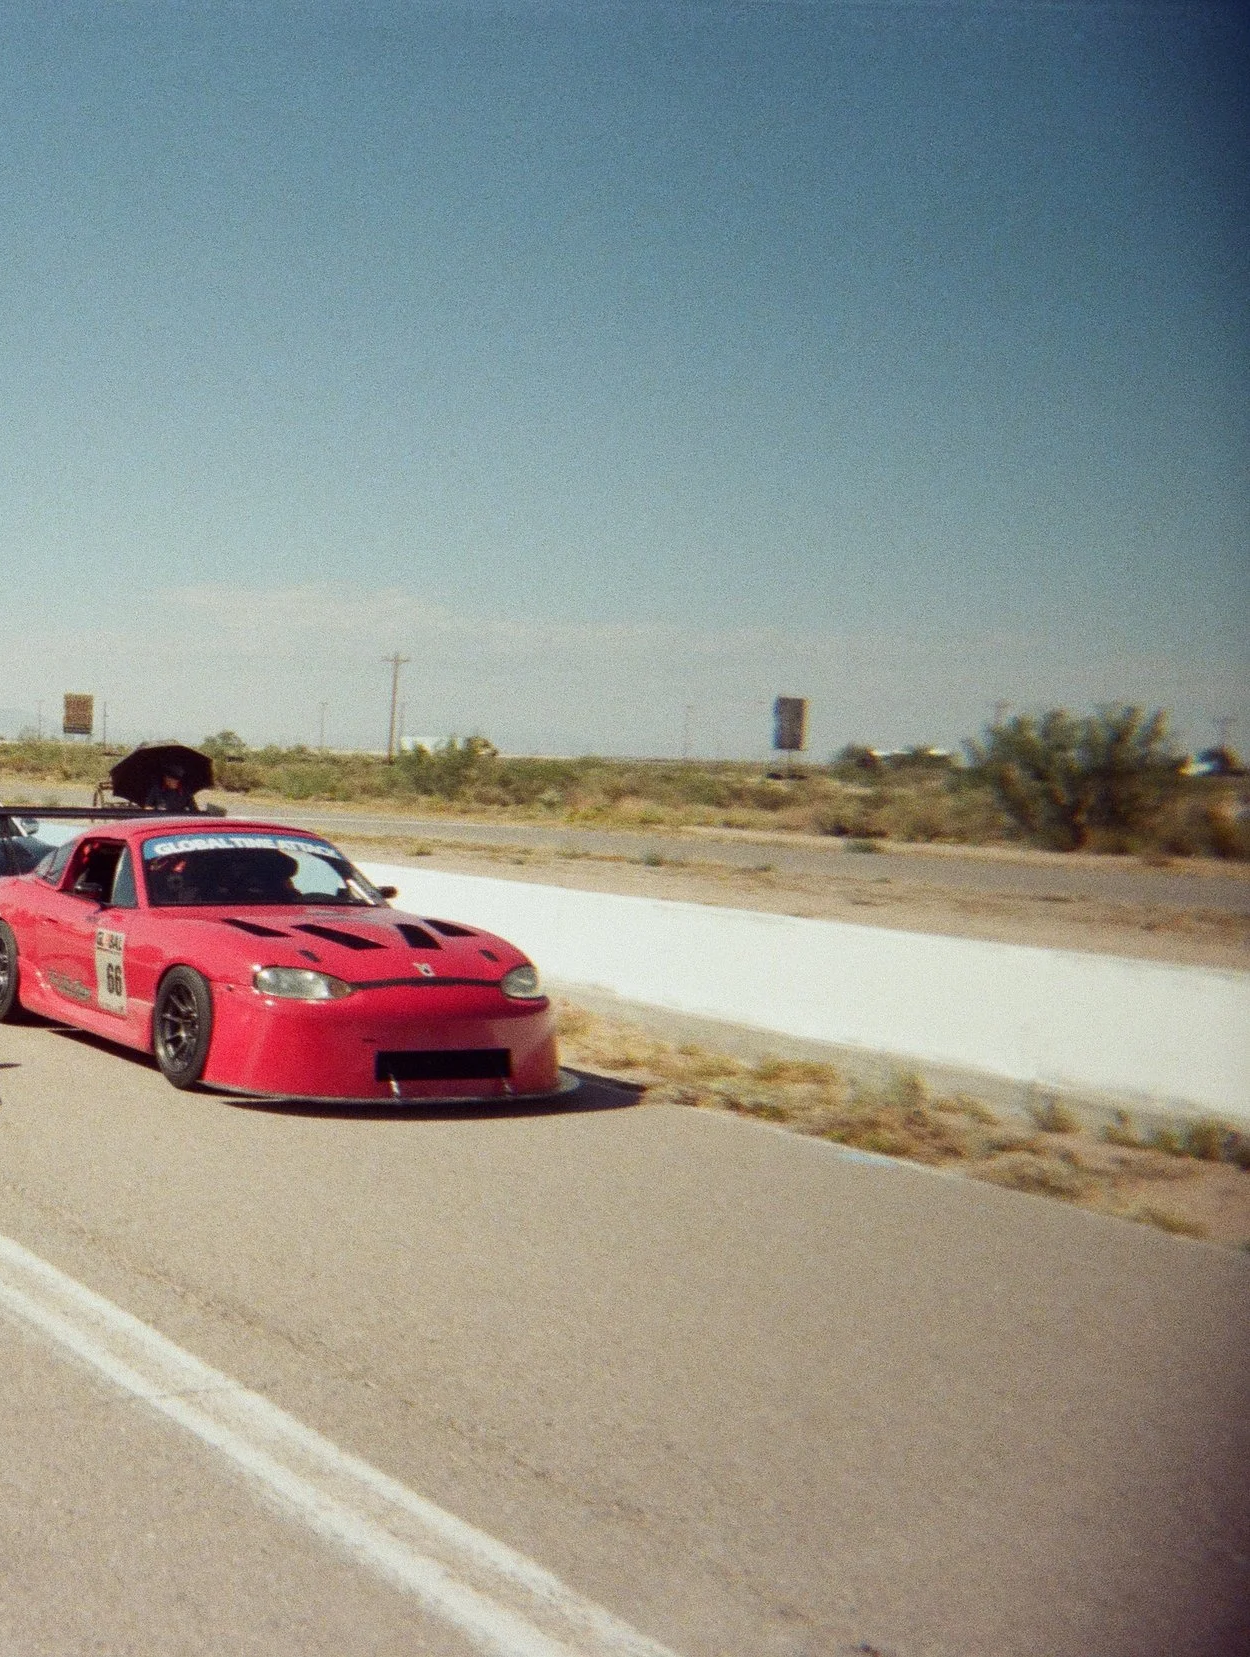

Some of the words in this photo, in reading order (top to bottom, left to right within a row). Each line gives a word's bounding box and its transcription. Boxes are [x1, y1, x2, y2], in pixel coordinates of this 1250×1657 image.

[153, 836, 229, 856] GLOBAL
[229, 837, 277, 849] TIME
[277, 839, 344, 860] ATTACK
[106, 963, 122, 997] 66
